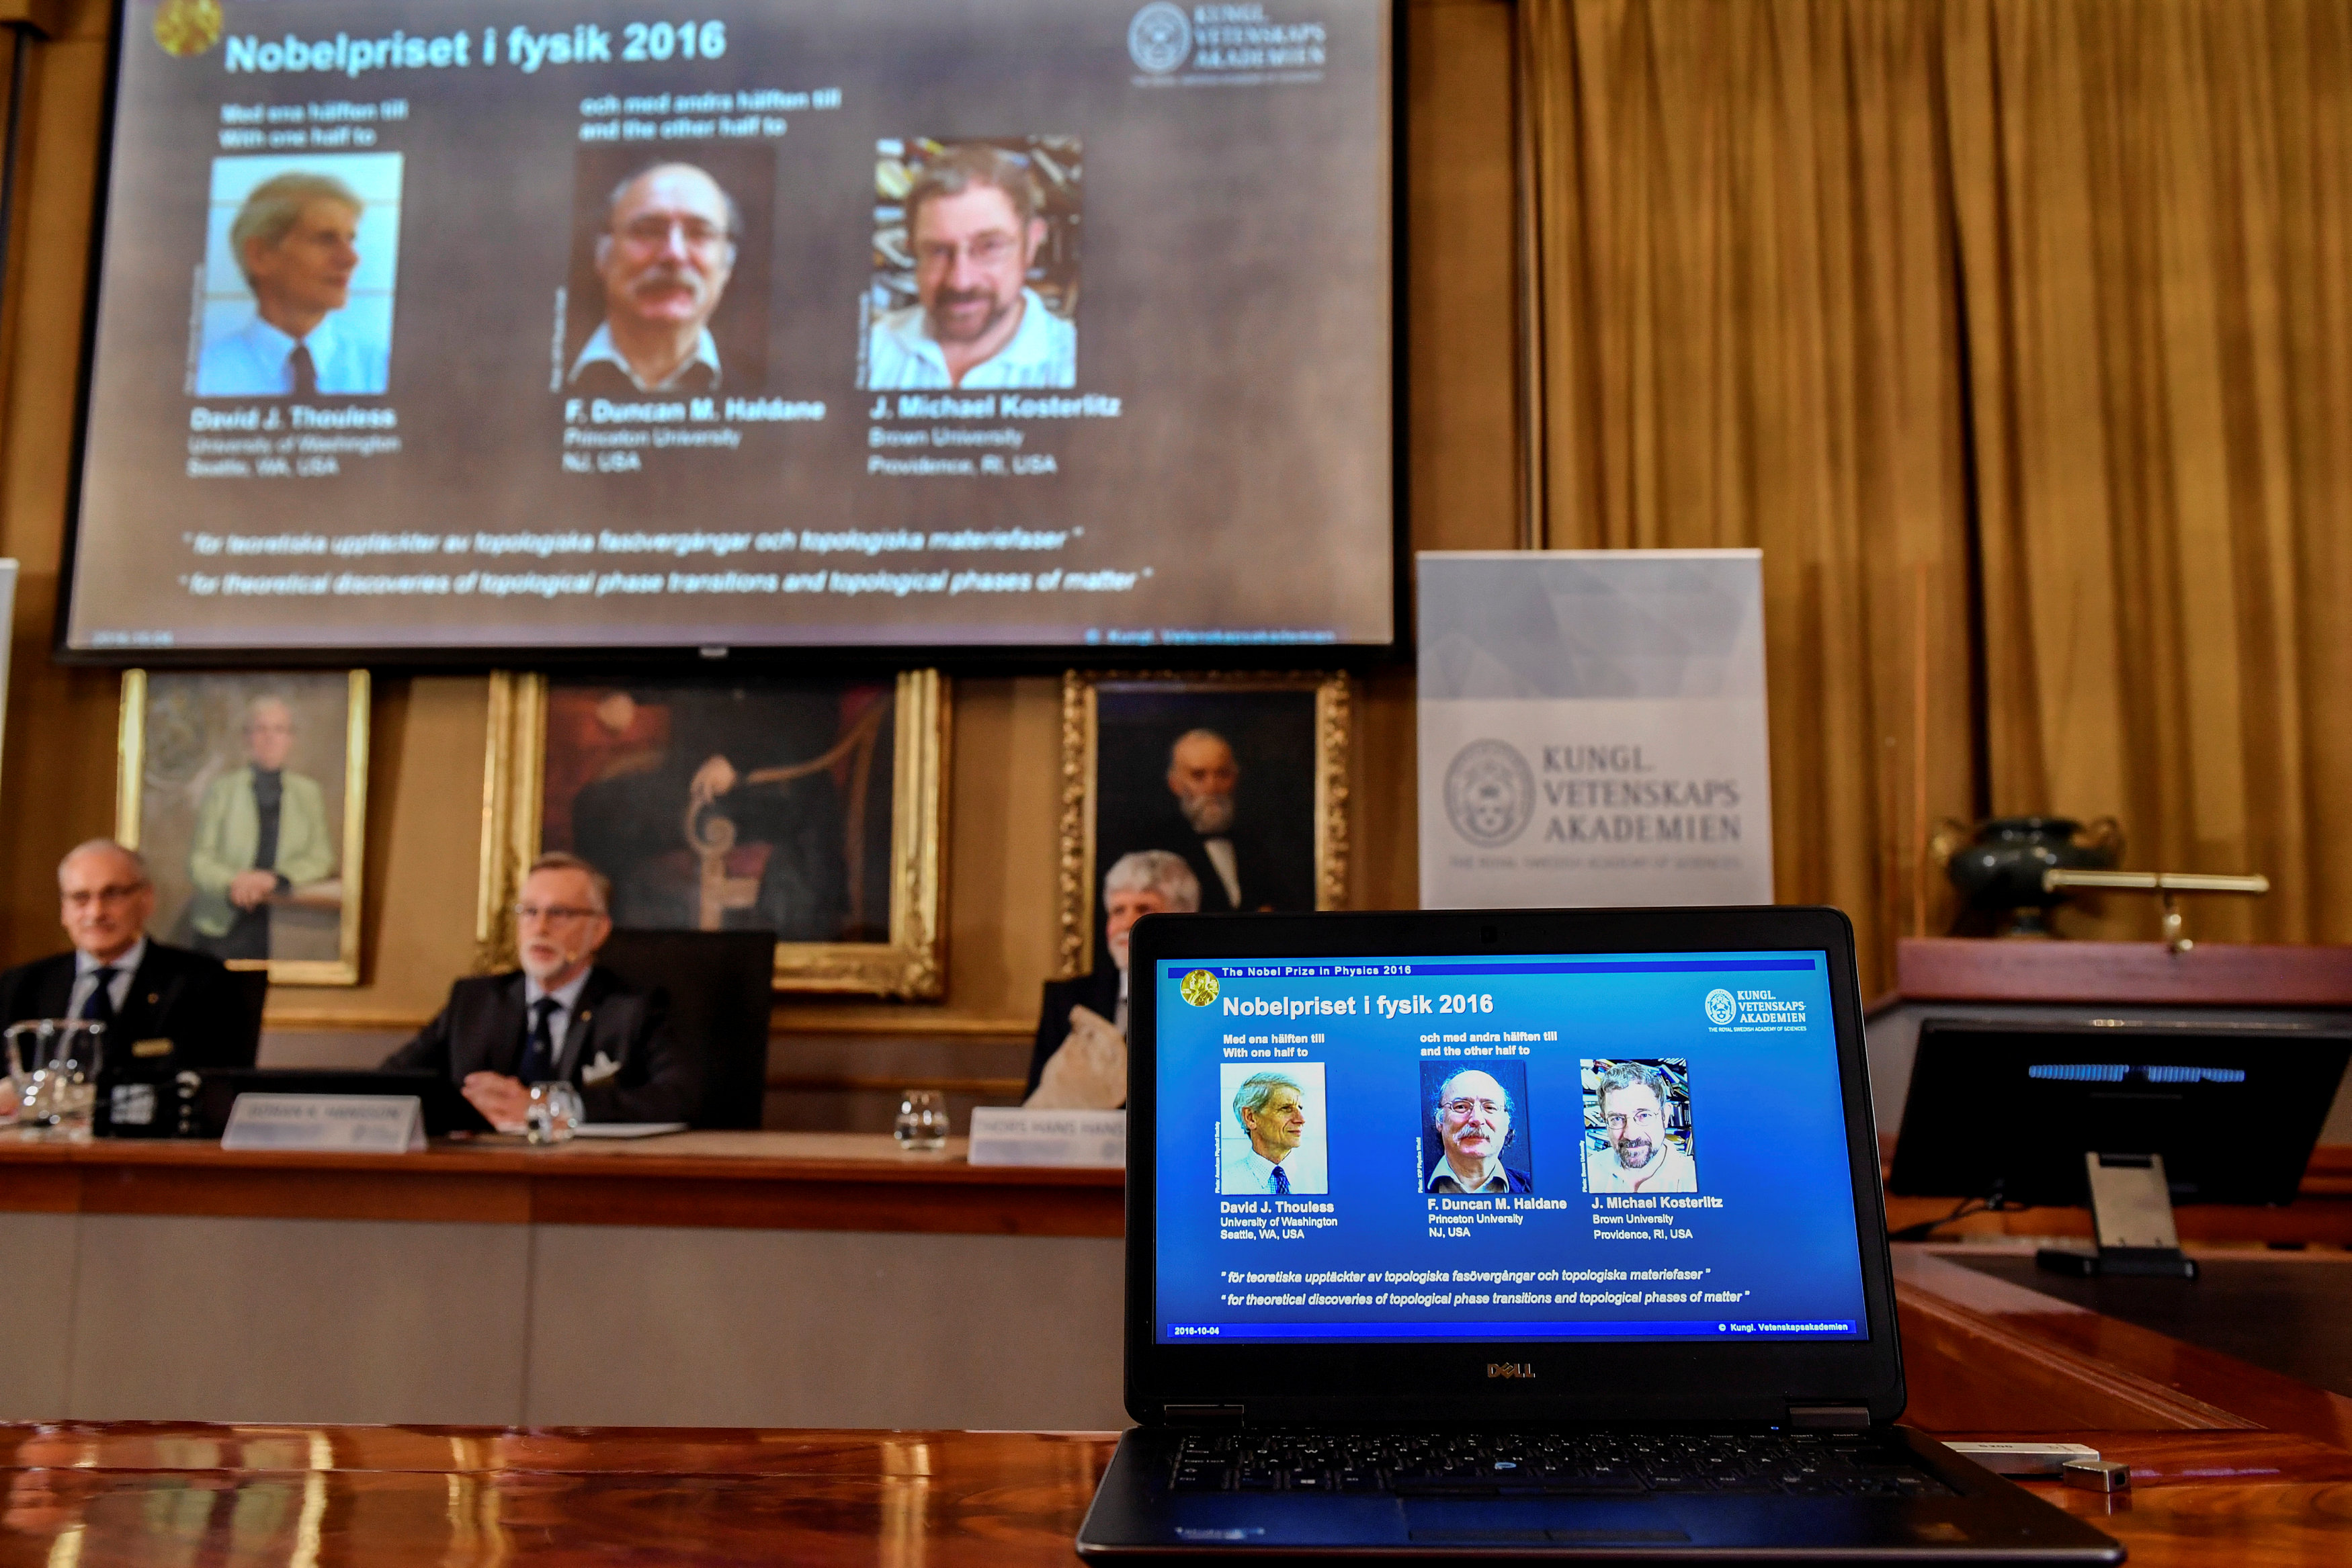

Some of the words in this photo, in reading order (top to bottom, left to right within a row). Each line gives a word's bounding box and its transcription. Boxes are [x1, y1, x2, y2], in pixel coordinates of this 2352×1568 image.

[225, 30, 470, 77] Nobelpriset
[482, 27, 497, 64] i
[507, 24, 611, 73] fysik
[622, 19, 726, 61] 2016
[1545, 814, 1741, 843] AKADEMIEN
[1222, 967, 1243, 977] The
[1248, 967, 1281, 976] Nobel
[1286, 967, 1315, 976] Prize
[1319, 966, 1330, 975] in
[1335, 965, 1379, 976] Physics
[1383, 965, 1411, 975] 2016
[1736, 990, 1776, 1000] KUNGL.
[1223, 996, 1357, 1020] Nobelpriset
[1364, 995, 1370, 1014] i
[1376, 994, 1433, 1018] fysik
[1439, 994, 1494, 1014] 2016
[1739, 1012, 1806, 1023] AKADEMIEN
[1223, 1034, 1246, 1045] Med
[1248, 1036, 1269, 1044] ena
[1271, 1033, 1308, 1044] hälften
[1310, 1033, 1325, 1043] till
[1419, 1032, 1441, 1043] och
[1443, 1032, 1467, 1043] med
[1469, 1031, 1501, 1043] andra
[1503, 1031, 1541, 1042] hälften
[1543, 1031, 1558, 1041] till
[1222, 1047, 1249, 1058] With
[1251, 1049, 1271, 1057] one
[1273, 1047, 1295, 1057] half
[1296, 1047, 1308, 1057] to
[1420, 1045, 1441, 1057] and
[1443, 1045, 1462, 1056] the
[1464, 1045, 1494, 1056] other
[1495, 1045, 1517, 1055] half
[1518, 1045, 1530, 1055] to
[1220, 1201, 1257, 1214] David
[1260, 1201, 1272, 1213] J.
[1275, 1201, 1335, 1213] Thouless
[1427, 1198, 1439, 1211] F.
[1441, 1198, 1492, 1211] Duncan
[1495, 1197, 1511, 1210] M.
[1513, 1197, 1568, 1210] Haldane
[1591, 1196, 1604, 1209] J.
[1606, 1196, 1657, 1209] Michael
[1660, 1196, 1724, 1209] Kosterlitz
[1220, 1217, 1267, 1229] University
[1269, 1216, 1280, 1227] of
[1280, 1216, 1338, 1229] Washington
[1428, 1214, 1474, 1224] Princeton
[1476, 1213, 1523, 1225] University
[1593, 1214, 1624, 1224] Brown
[1626, 1213, 1674, 1225] University
[1220, 1229, 1257, 1241] Seattle,
[1259, 1229, 1280, 1240] WA,
[1282, 1229, 1305, 1239] USA
[1429, 1227, 1445, 1239] NJ,
[1447, 1227, 1471, 1237] USA
[1593, 1229, 1651, 1240] Providence,
[1653, 1229, 1668, 1240] RI,
[1670, 1229, 1693, 1239] USA
[1228, 1271, 1245, 1283] för
[1246, 1270, 1302, 1283] teoretiska
[1304, 1270, 1366, 1285] upptäckter
[1367, 1272, 1383, 1282] av
[1384, 1270, 1450, 1285] topologiska
[1452, 1270, 1536, 1284] fasövergångar
[1537, 1269, 1559, 1281] och
[1562, 1268, 1628, 1284] topologiska
[1630, 1268, 1704, 1280] materiefaser
[1227, 1293, 1245, 1306] for
[1246, 1293, 1306, 1306] theoretical
[1308, 1293, 1374, 1305] discoveries
[1375, 1293, 1389, 1305] of
[1389, 1292, 1452, 1307] topological
[1453, 1292, 1490, 1307] phase
[1493, 1291, 1552, 1304] transitions
[1554, 1291, 1578, 1304] and
[1579, 1291, 1642, 1306] topological
[1644, 1291, 1687, 1306] phases
[1689, 1291, 1703, 1303] of
[1704, 1291, 1743, 1303] matter
[1174, 1327, 1220, 1336] 2016-10-04
[1730, 1323, 1757, 1333] Kungl.
[1758, 1323, 1848, 1332] Vetenskapsakademien
[1487, 1362, 1536, 1379] DELL
